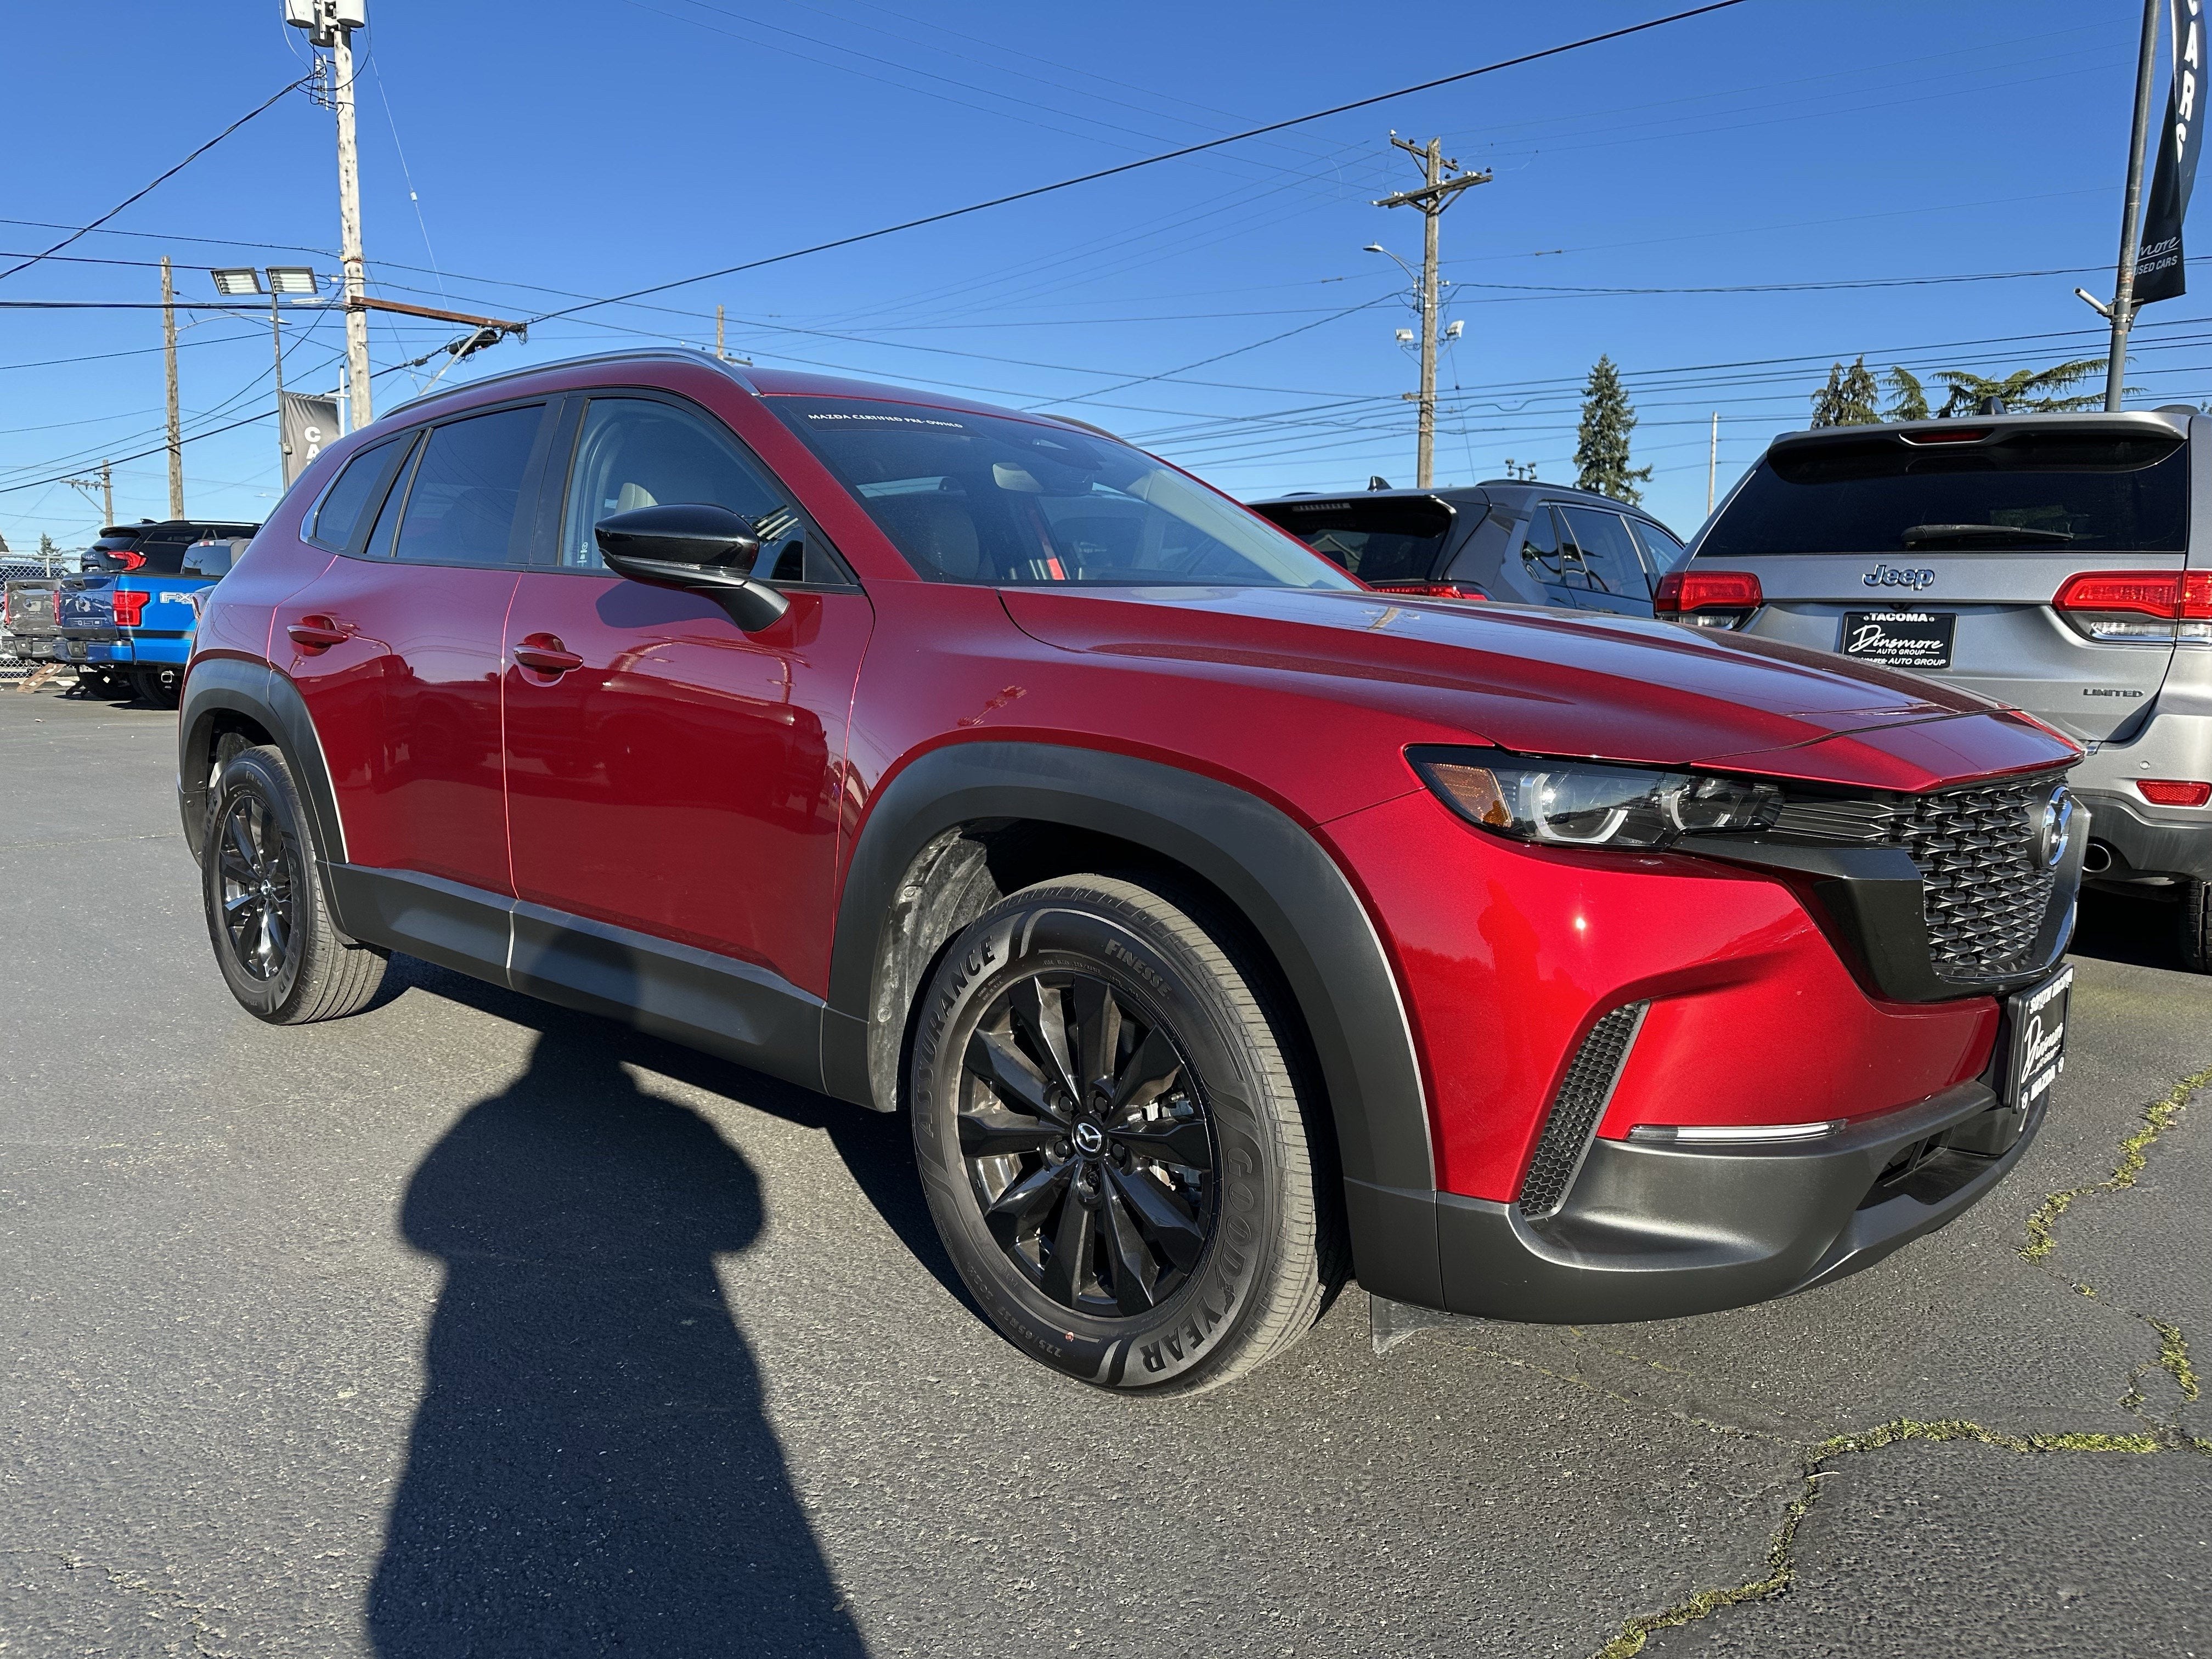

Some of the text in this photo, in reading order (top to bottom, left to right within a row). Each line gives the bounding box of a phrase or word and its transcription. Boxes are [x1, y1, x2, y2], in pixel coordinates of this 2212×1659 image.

[2156, 255, 2178, 270] CARS
[904, 417, 963, 428] PRE-OWNED
[304, 426, 321, 465] CA
[1862, 563, 1935, 591] Jeep
[1870, 612, 1928, 622] TACOMA
[1848, 624, 1944, 653] Dinsmore
[2083, 689, 2145, 697] LIMITED
[1104, 939, 1172, 998] FINESSE
[916, 935, 996, 1138] ASSURANCE
[2030, 1064, 2056, 1101] MAZDA
